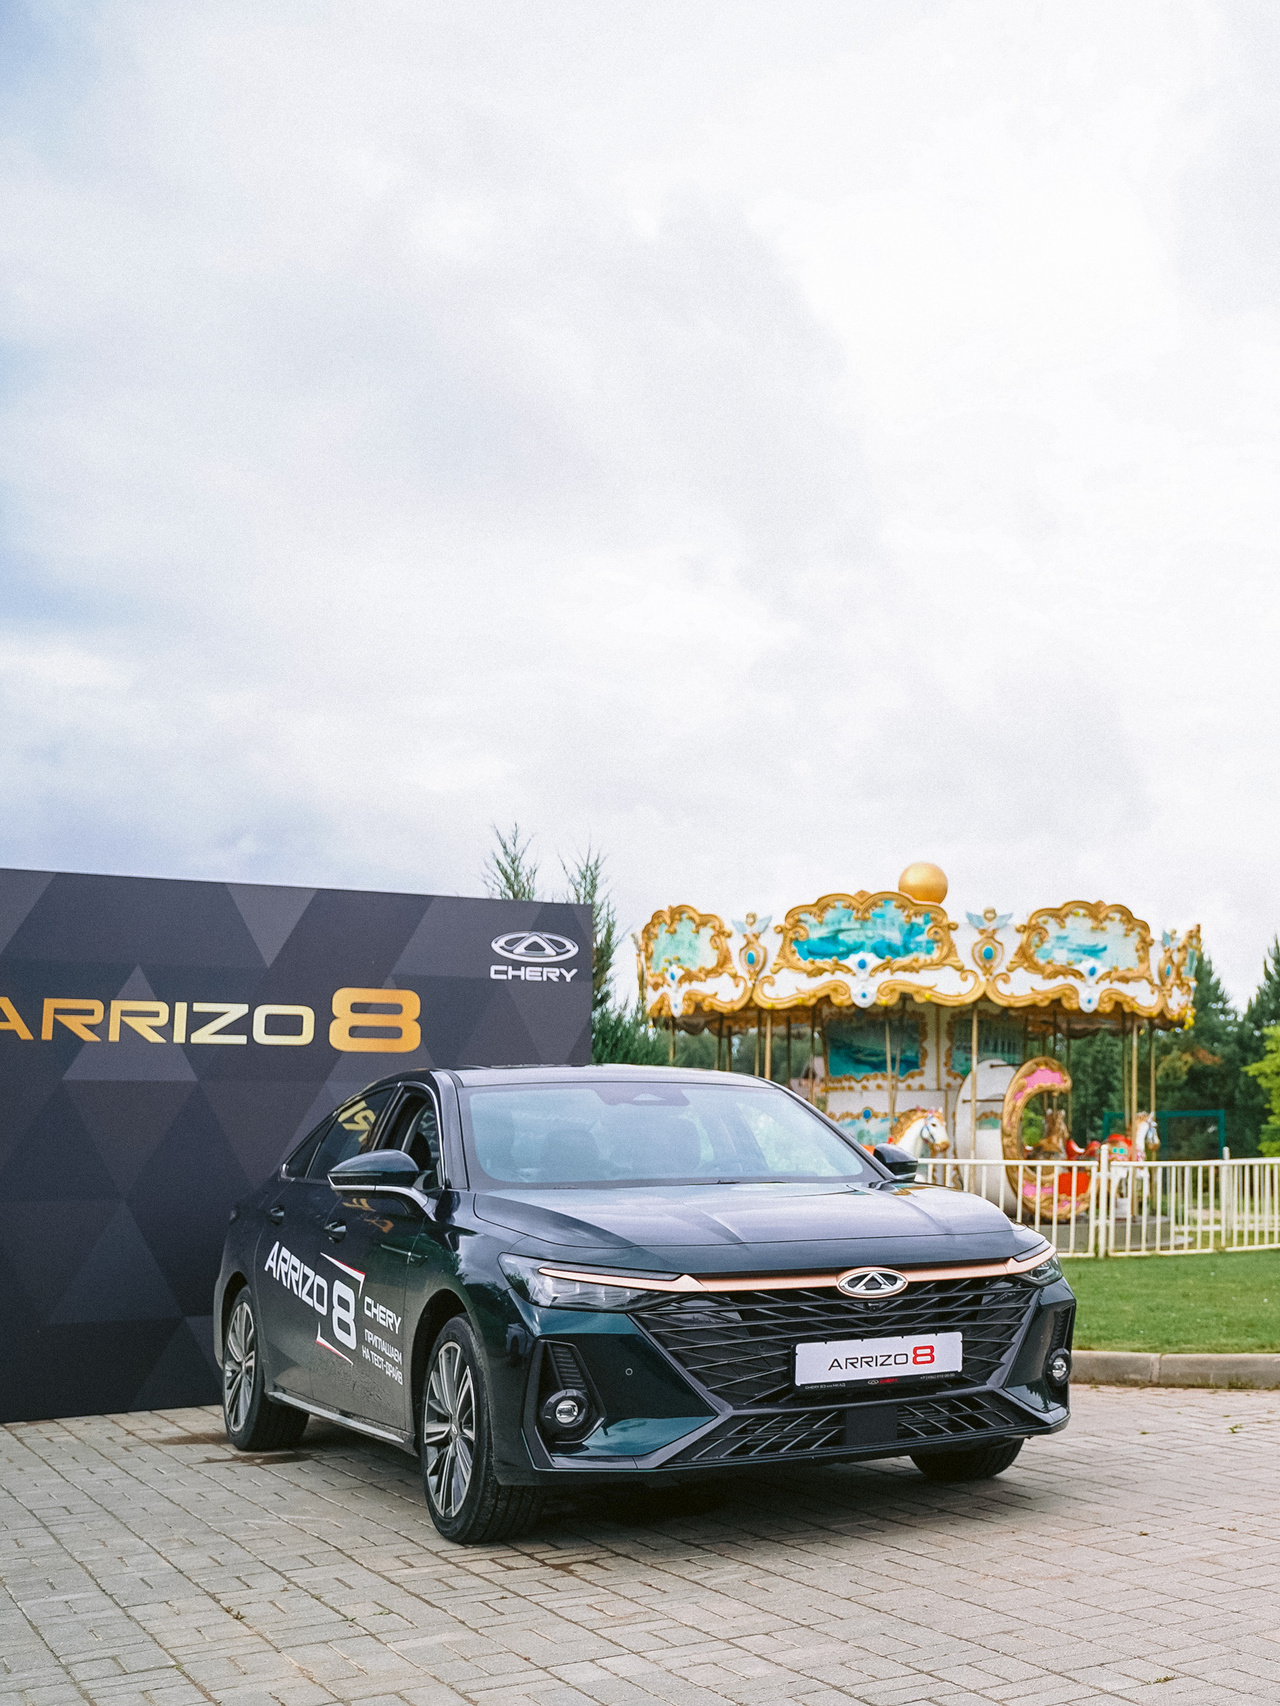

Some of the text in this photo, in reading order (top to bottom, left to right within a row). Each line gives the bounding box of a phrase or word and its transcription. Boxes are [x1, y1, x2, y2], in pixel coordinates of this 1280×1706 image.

[490, 964, 578, 983] CHERY
[328, 987, 422, 1053] 8
[264, 1241, 357, 1350] ARRIZO 8
[364, 1296, 402, 1335] CHERY
[361, 1344, 372, 1362] НА
[828, 1345, 935, 1371] ARRIZO 8
